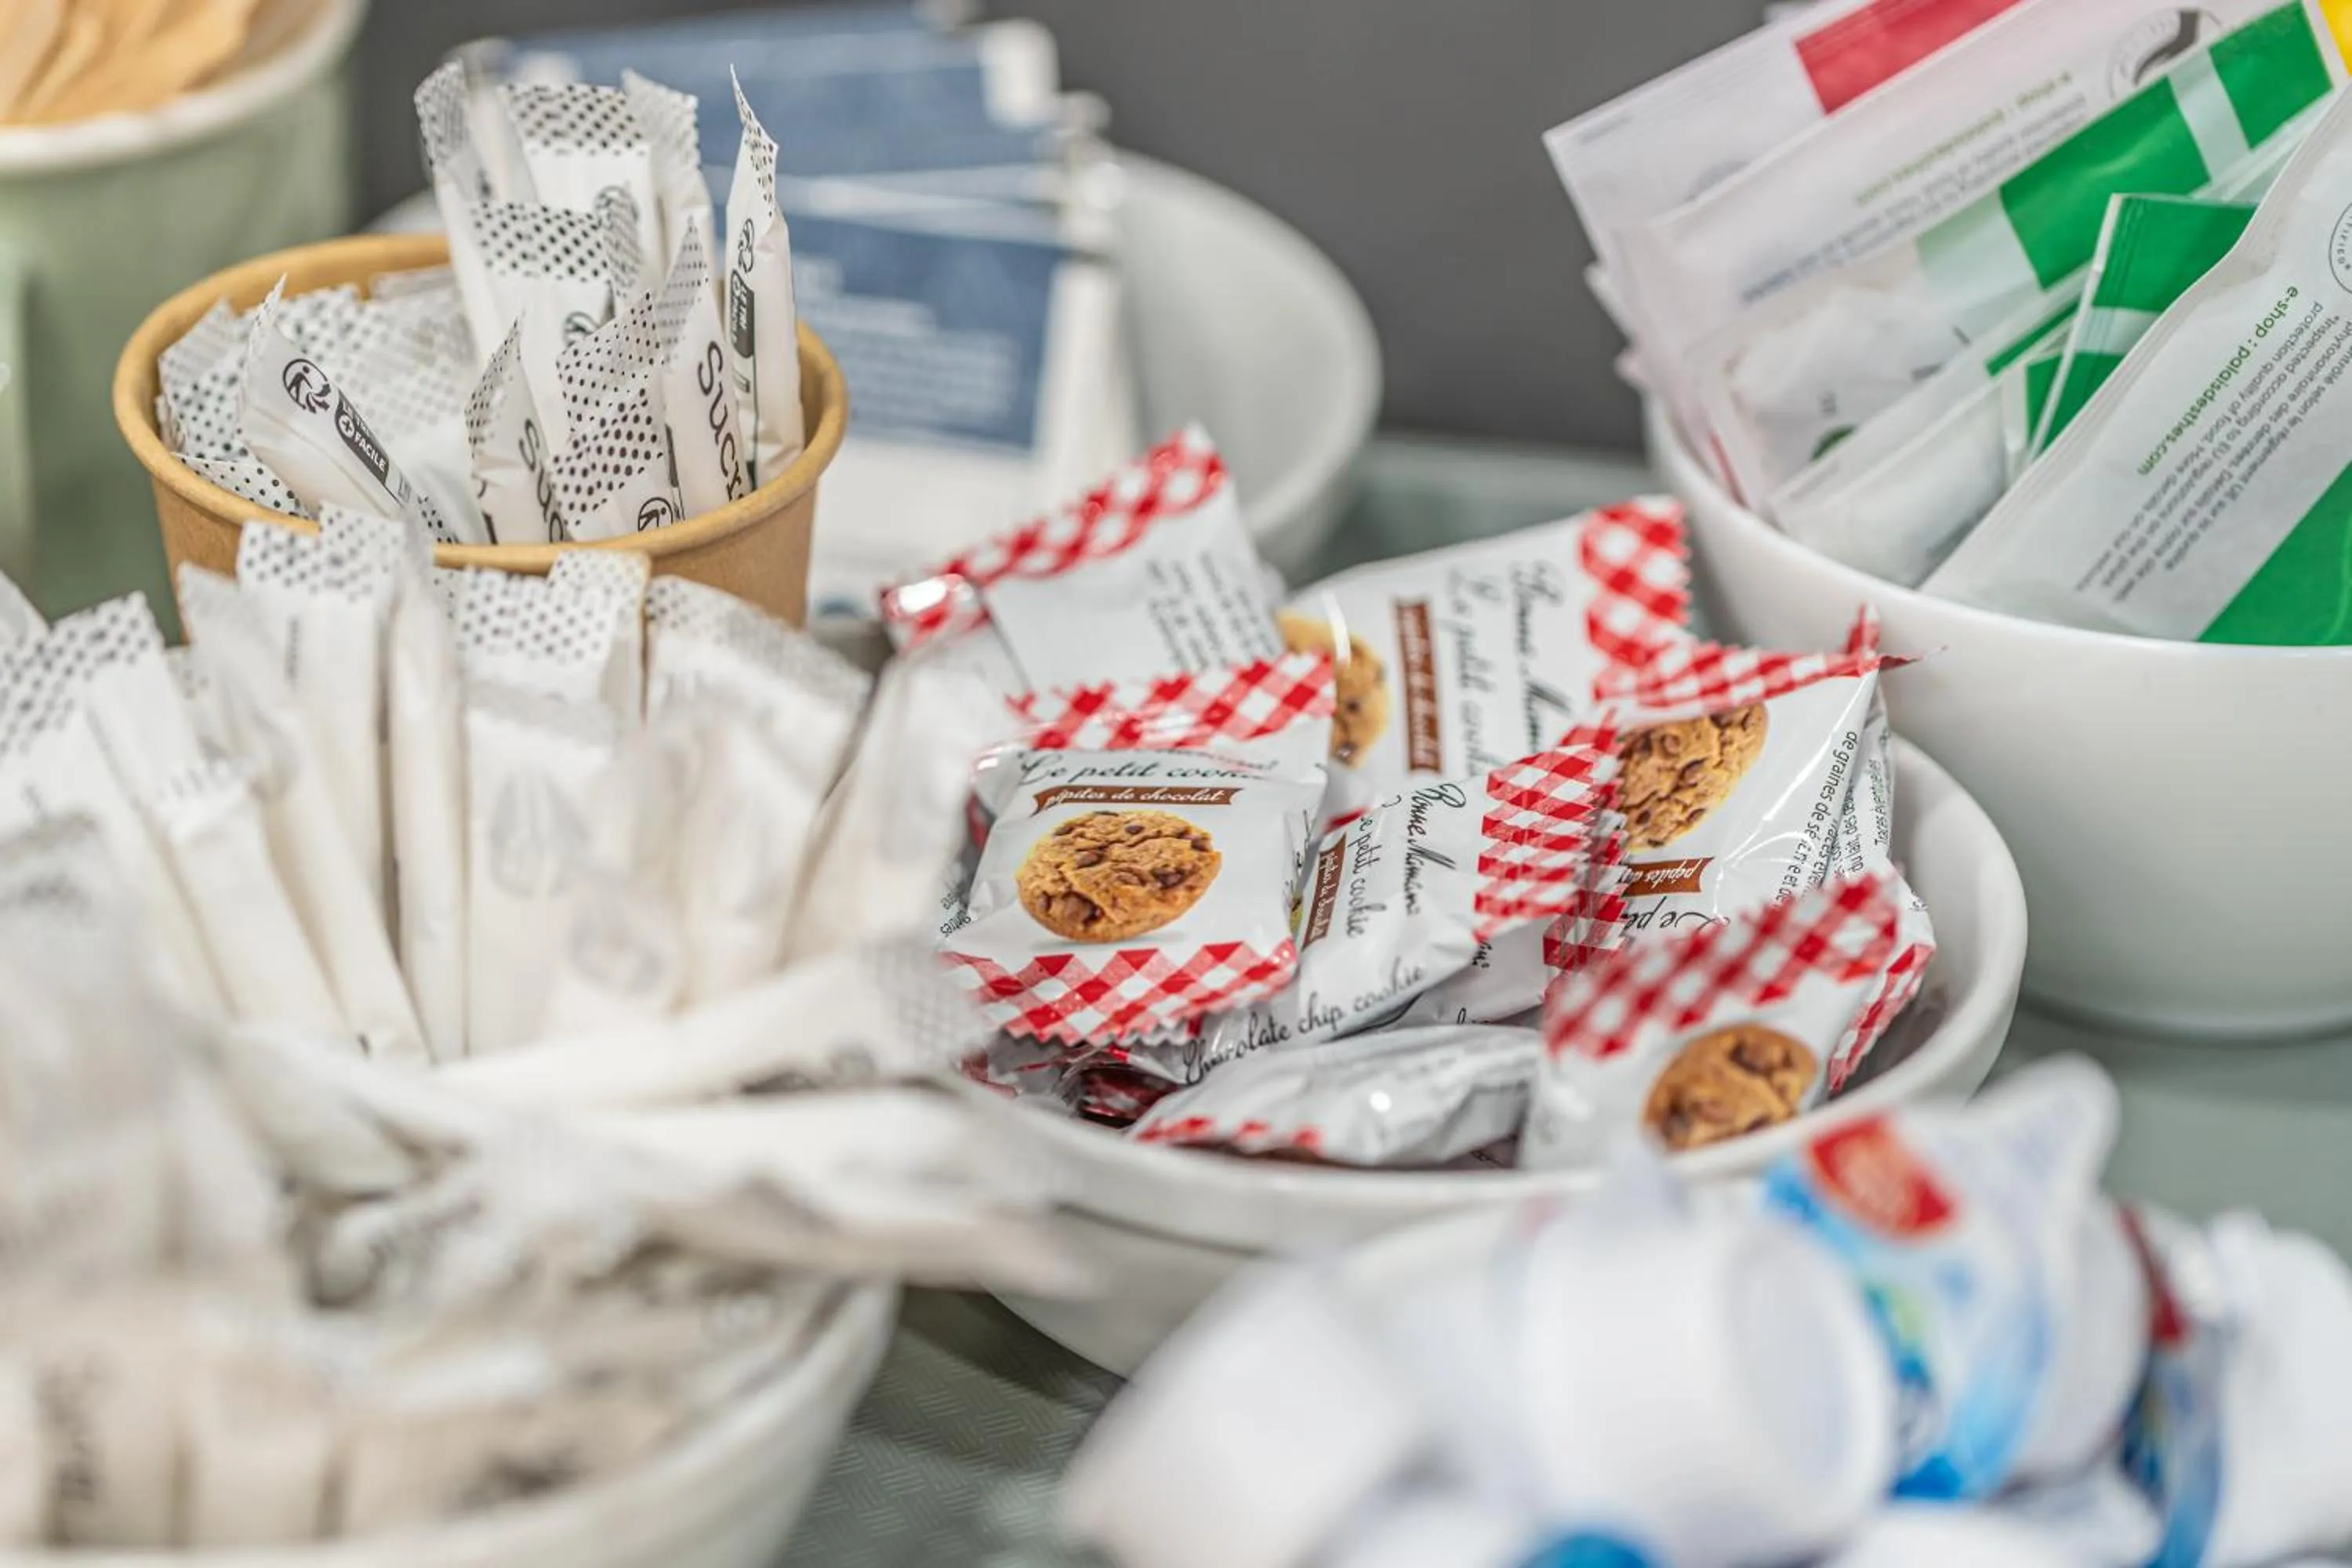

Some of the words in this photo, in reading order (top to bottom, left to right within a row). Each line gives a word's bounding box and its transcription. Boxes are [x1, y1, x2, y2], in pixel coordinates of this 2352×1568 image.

[2255, 285, 2299, 339] e-shop
[2271, 301, 2324, 363] protection
[2238, 362, 2274, 402] quality
[2287, 321, 2352, 403] phytosanitaire
[2323, 347, 2352, 385] ntrôlé
[2137, 345, 2251, 476] palaisdesthes.com
[2234, 372, 2288, 428] according
[2268, 402, 2289, 423] des
[2297, 385, 2326, 416] selon
[697, 341, 746, 503] Sucr
[354, 430, 387, 472] FACILE
[518, 418, 565, 543] Suc
[1842, 731, 1858, 750] de
[1067, 761, 1160, 783] petit
[1820, 749, 1850, 802] graines
[1111, 787, 1135, 801] de
[1139, 786, 1225, 802] chocolat
[1406, 782, 1466, 837] Bonne
[1811, 803, 1831, 822] de
[1842, 815, 1857, 835] des
[1346, 833, 1381, 874] petit
[1849, 855, 1864, 873] du
[1347, 877, 1388, 938] cookie
[1181, 1011, 1291, 1086] Chocolate
[1298, 992, 1347, 1035] chip
